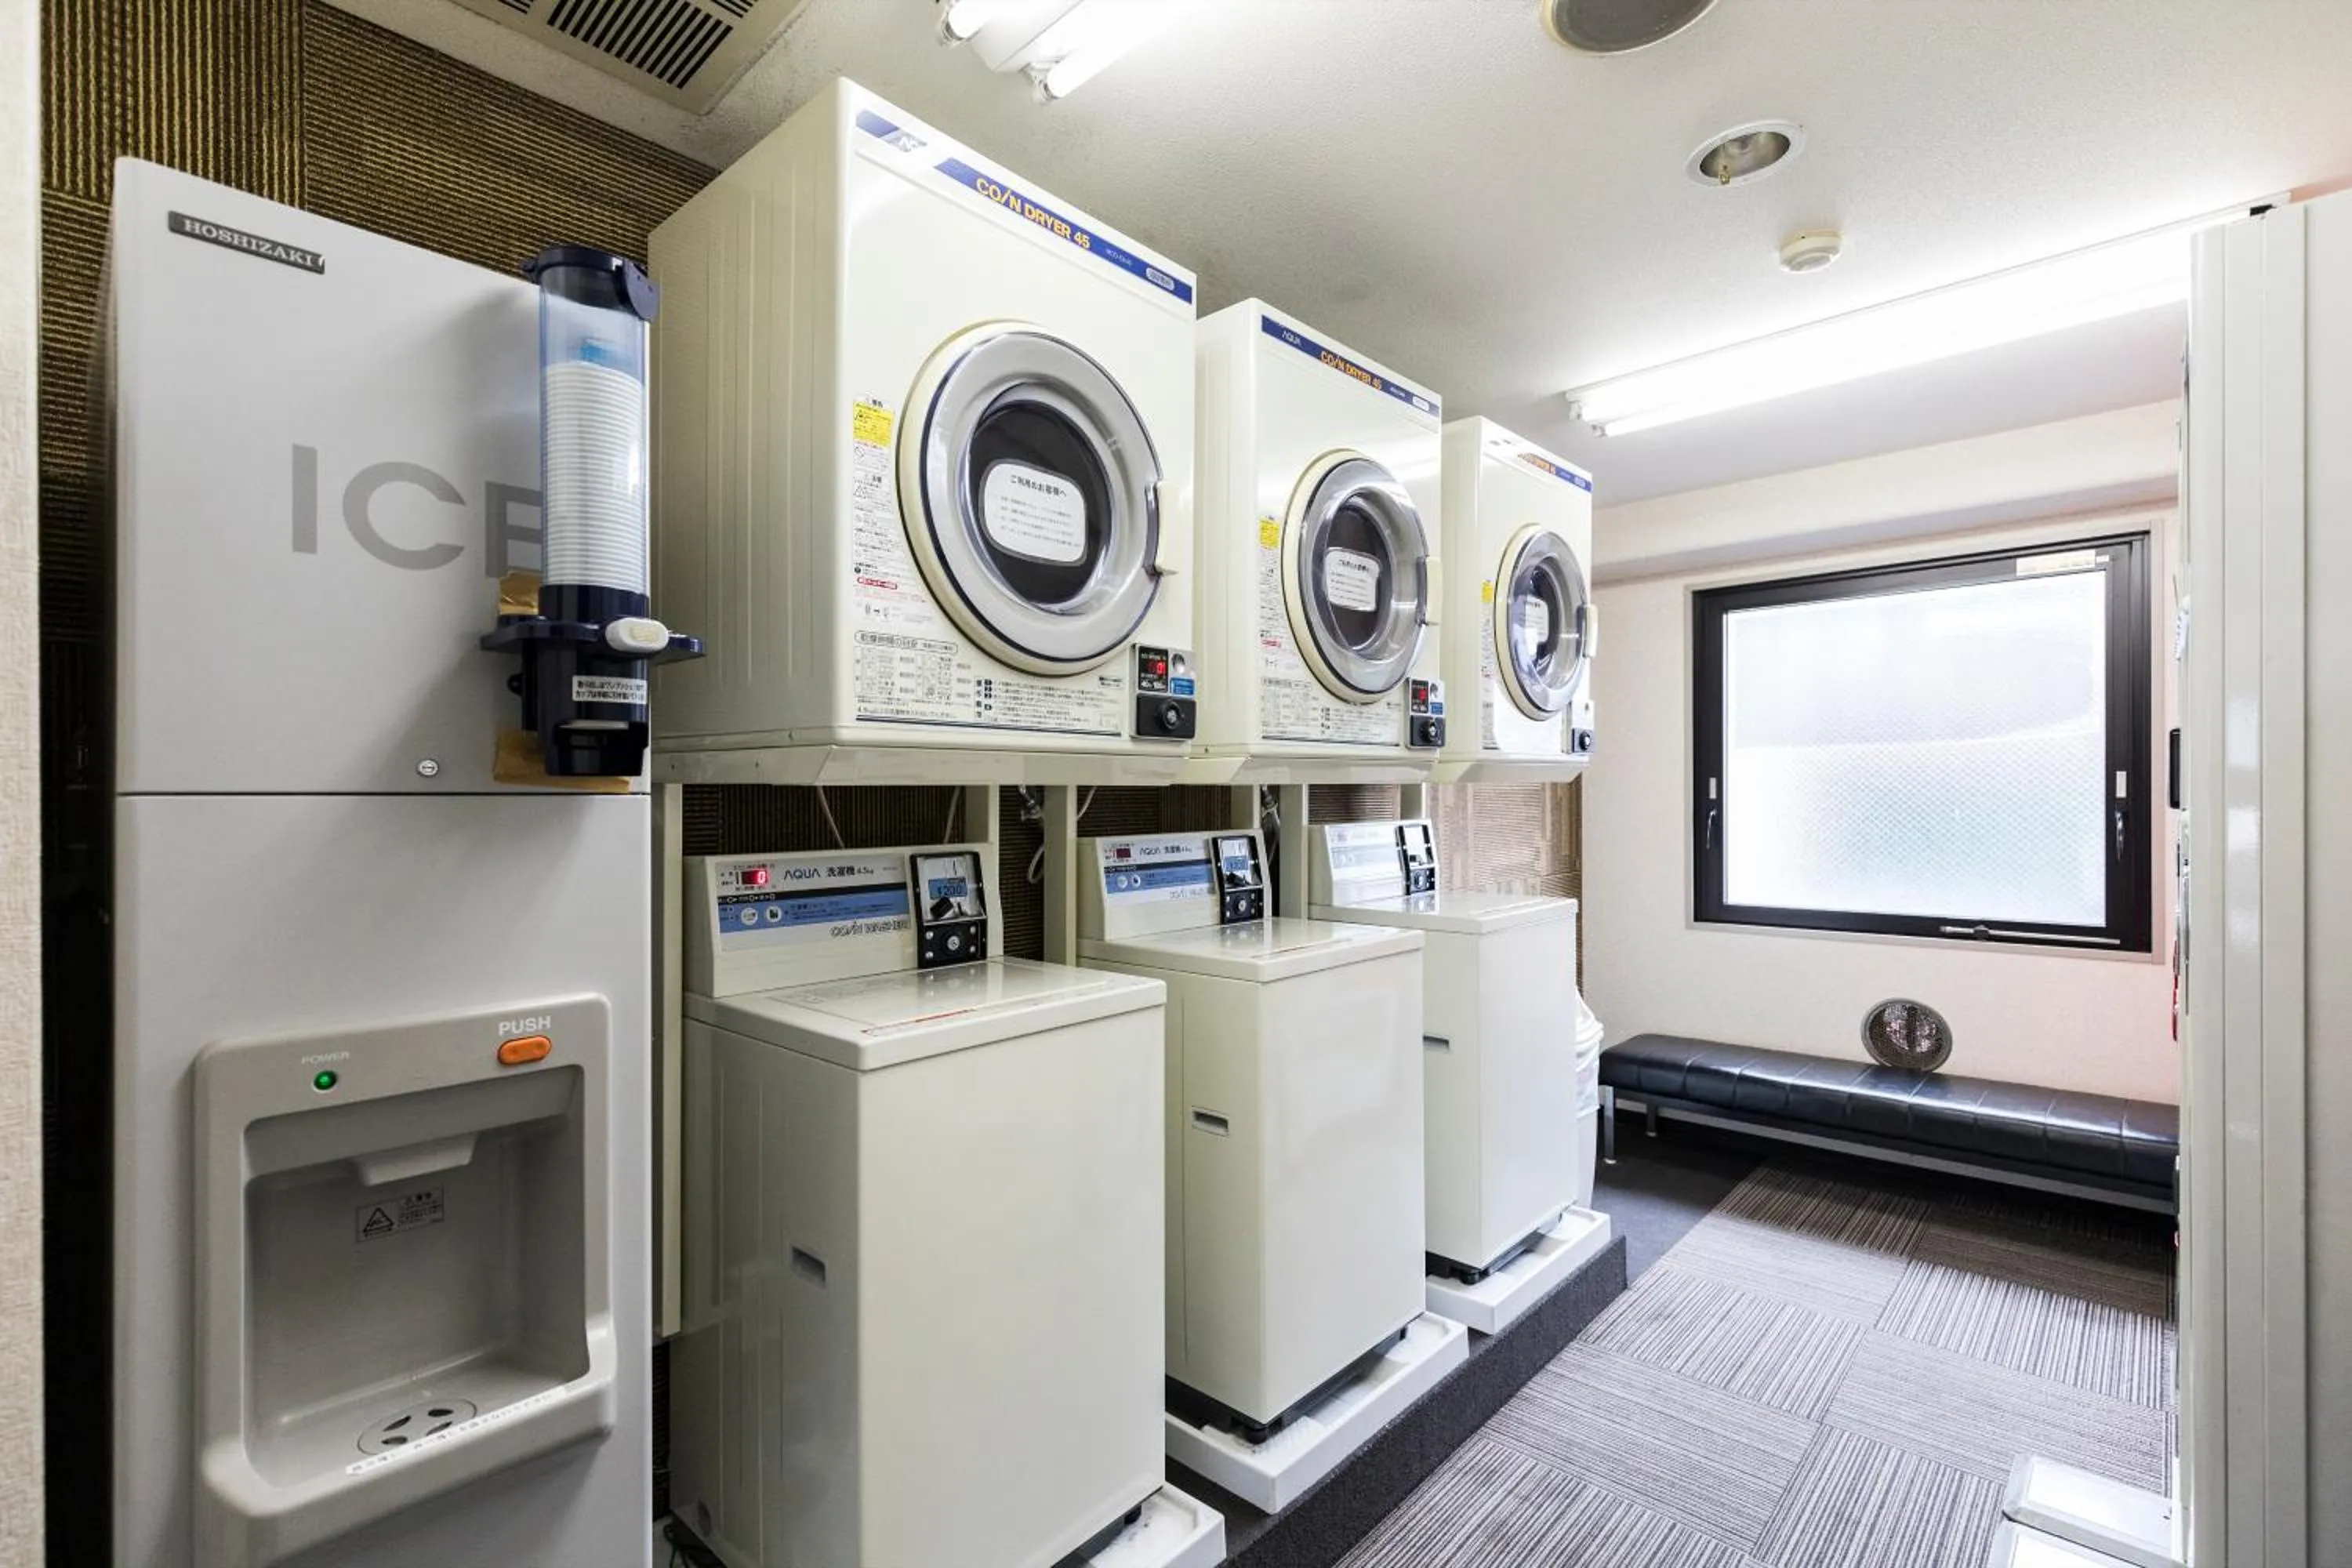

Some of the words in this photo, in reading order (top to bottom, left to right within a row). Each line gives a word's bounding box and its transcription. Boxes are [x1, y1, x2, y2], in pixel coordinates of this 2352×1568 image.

[1025, 203, 1071, 239] DRYER
[1073, 231, 1091, 249] 45
[183, 218, 314, 267] HOSHIZAKI
[783, 867, 821, 880] AQUA
[498, 1015, 552, 1036] PUSH
[301, 1051, 350, 1065] POWER
